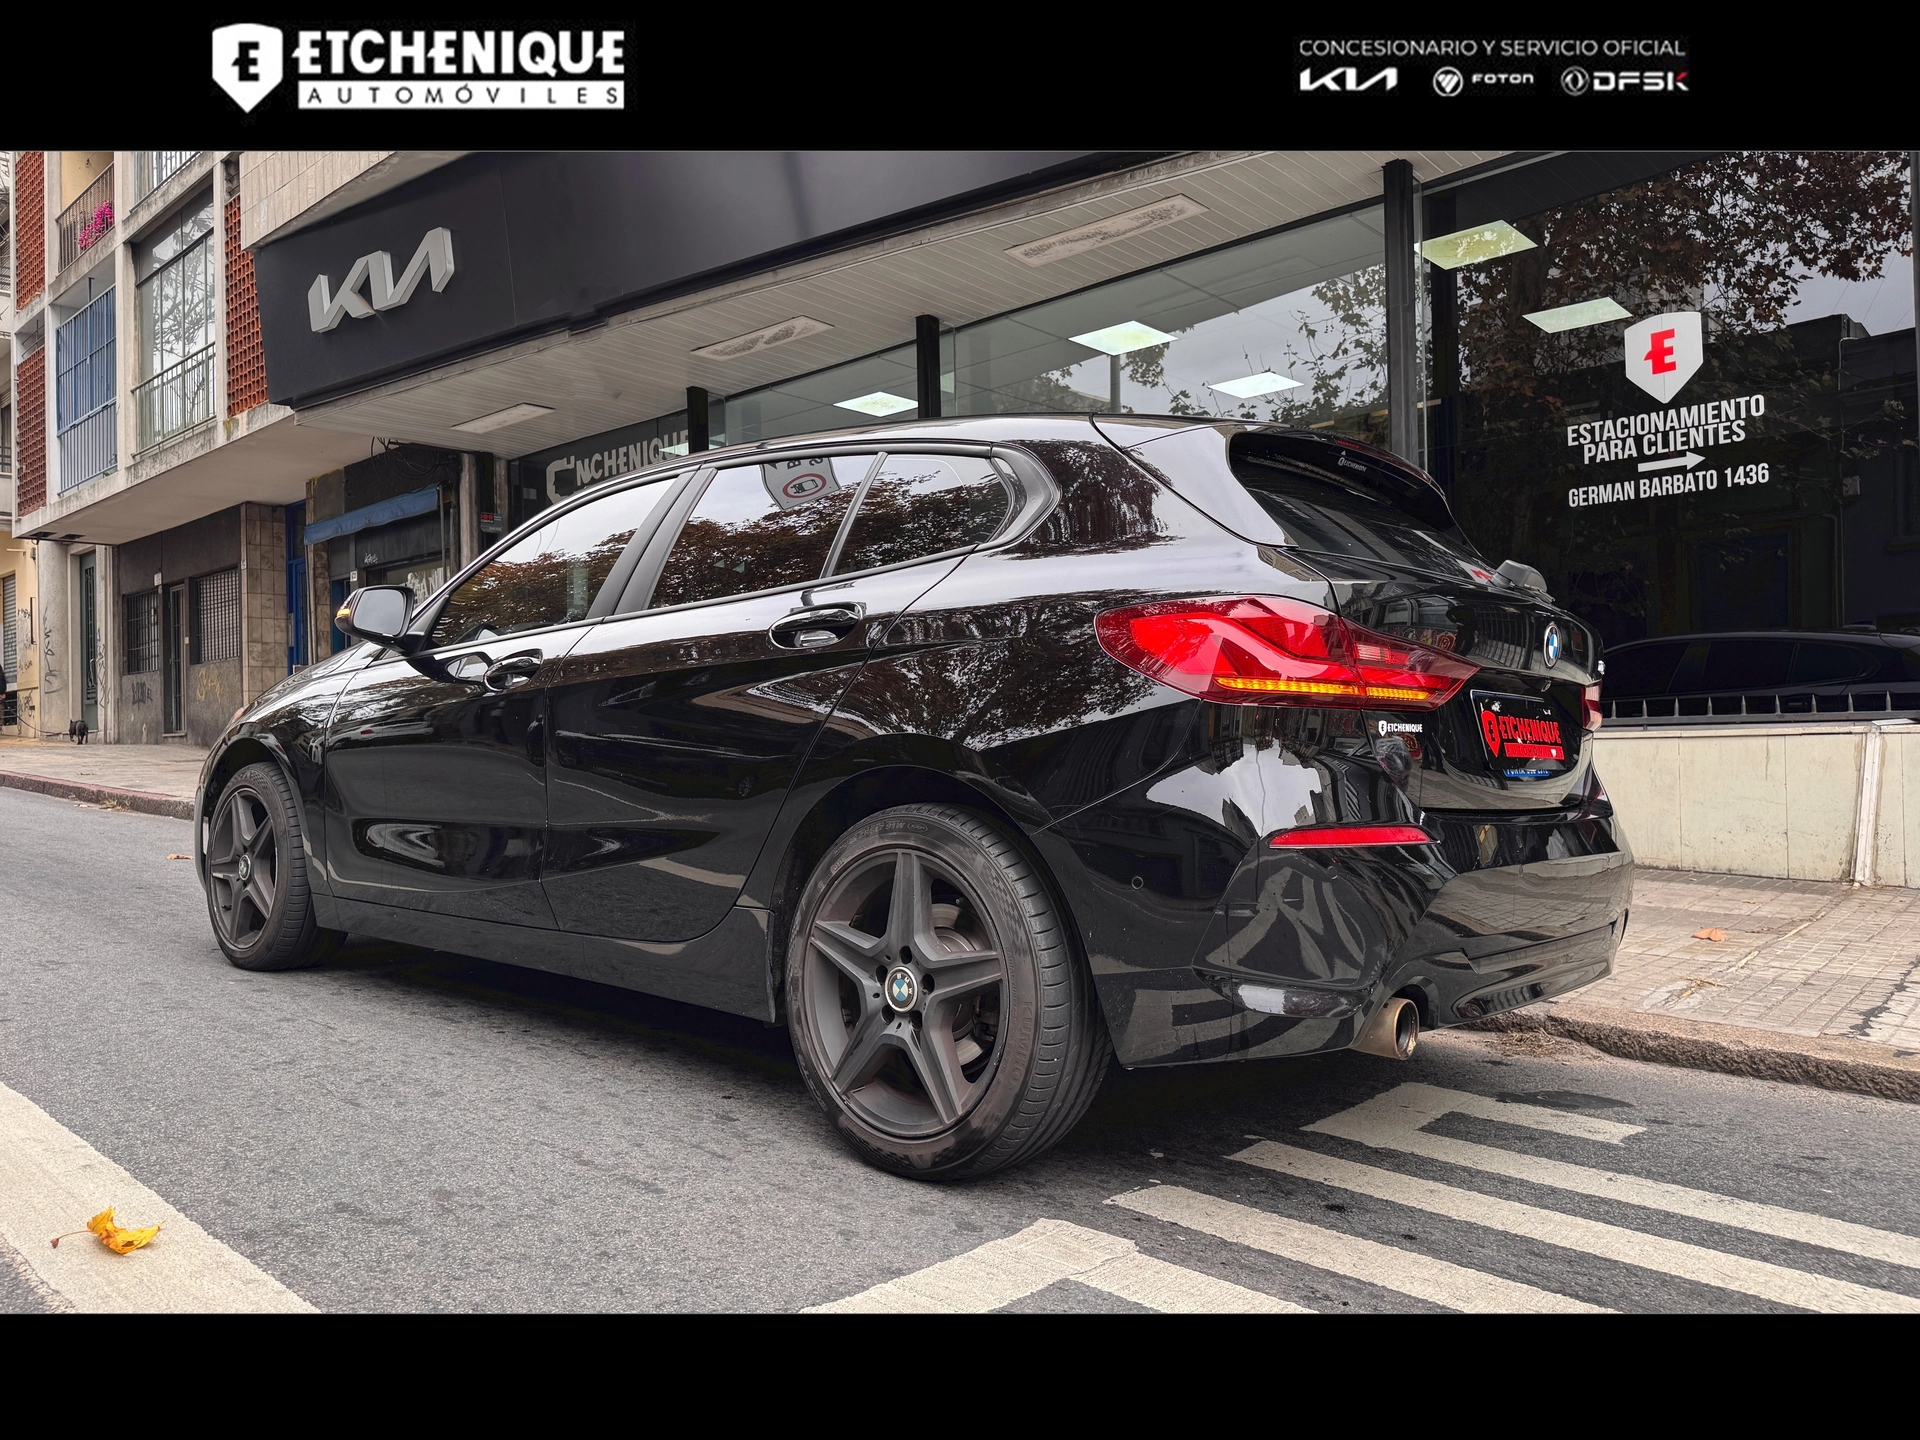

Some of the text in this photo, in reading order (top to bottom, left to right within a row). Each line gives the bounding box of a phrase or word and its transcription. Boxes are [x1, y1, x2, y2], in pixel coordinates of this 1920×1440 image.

[307, 226, 456, 334] KIA
[1567, 394, 1765, 447] ESTACIONAMIENTO
[1583, 420, 1746, 465] PARA CLIENTES
[1568, 462, 1770, 508] GERMAN BARBATO 1436
[1387, 722, 1423, 733] ETCHENIQUE
[1498, 716, 1561, 743] ETCHENIQUE
